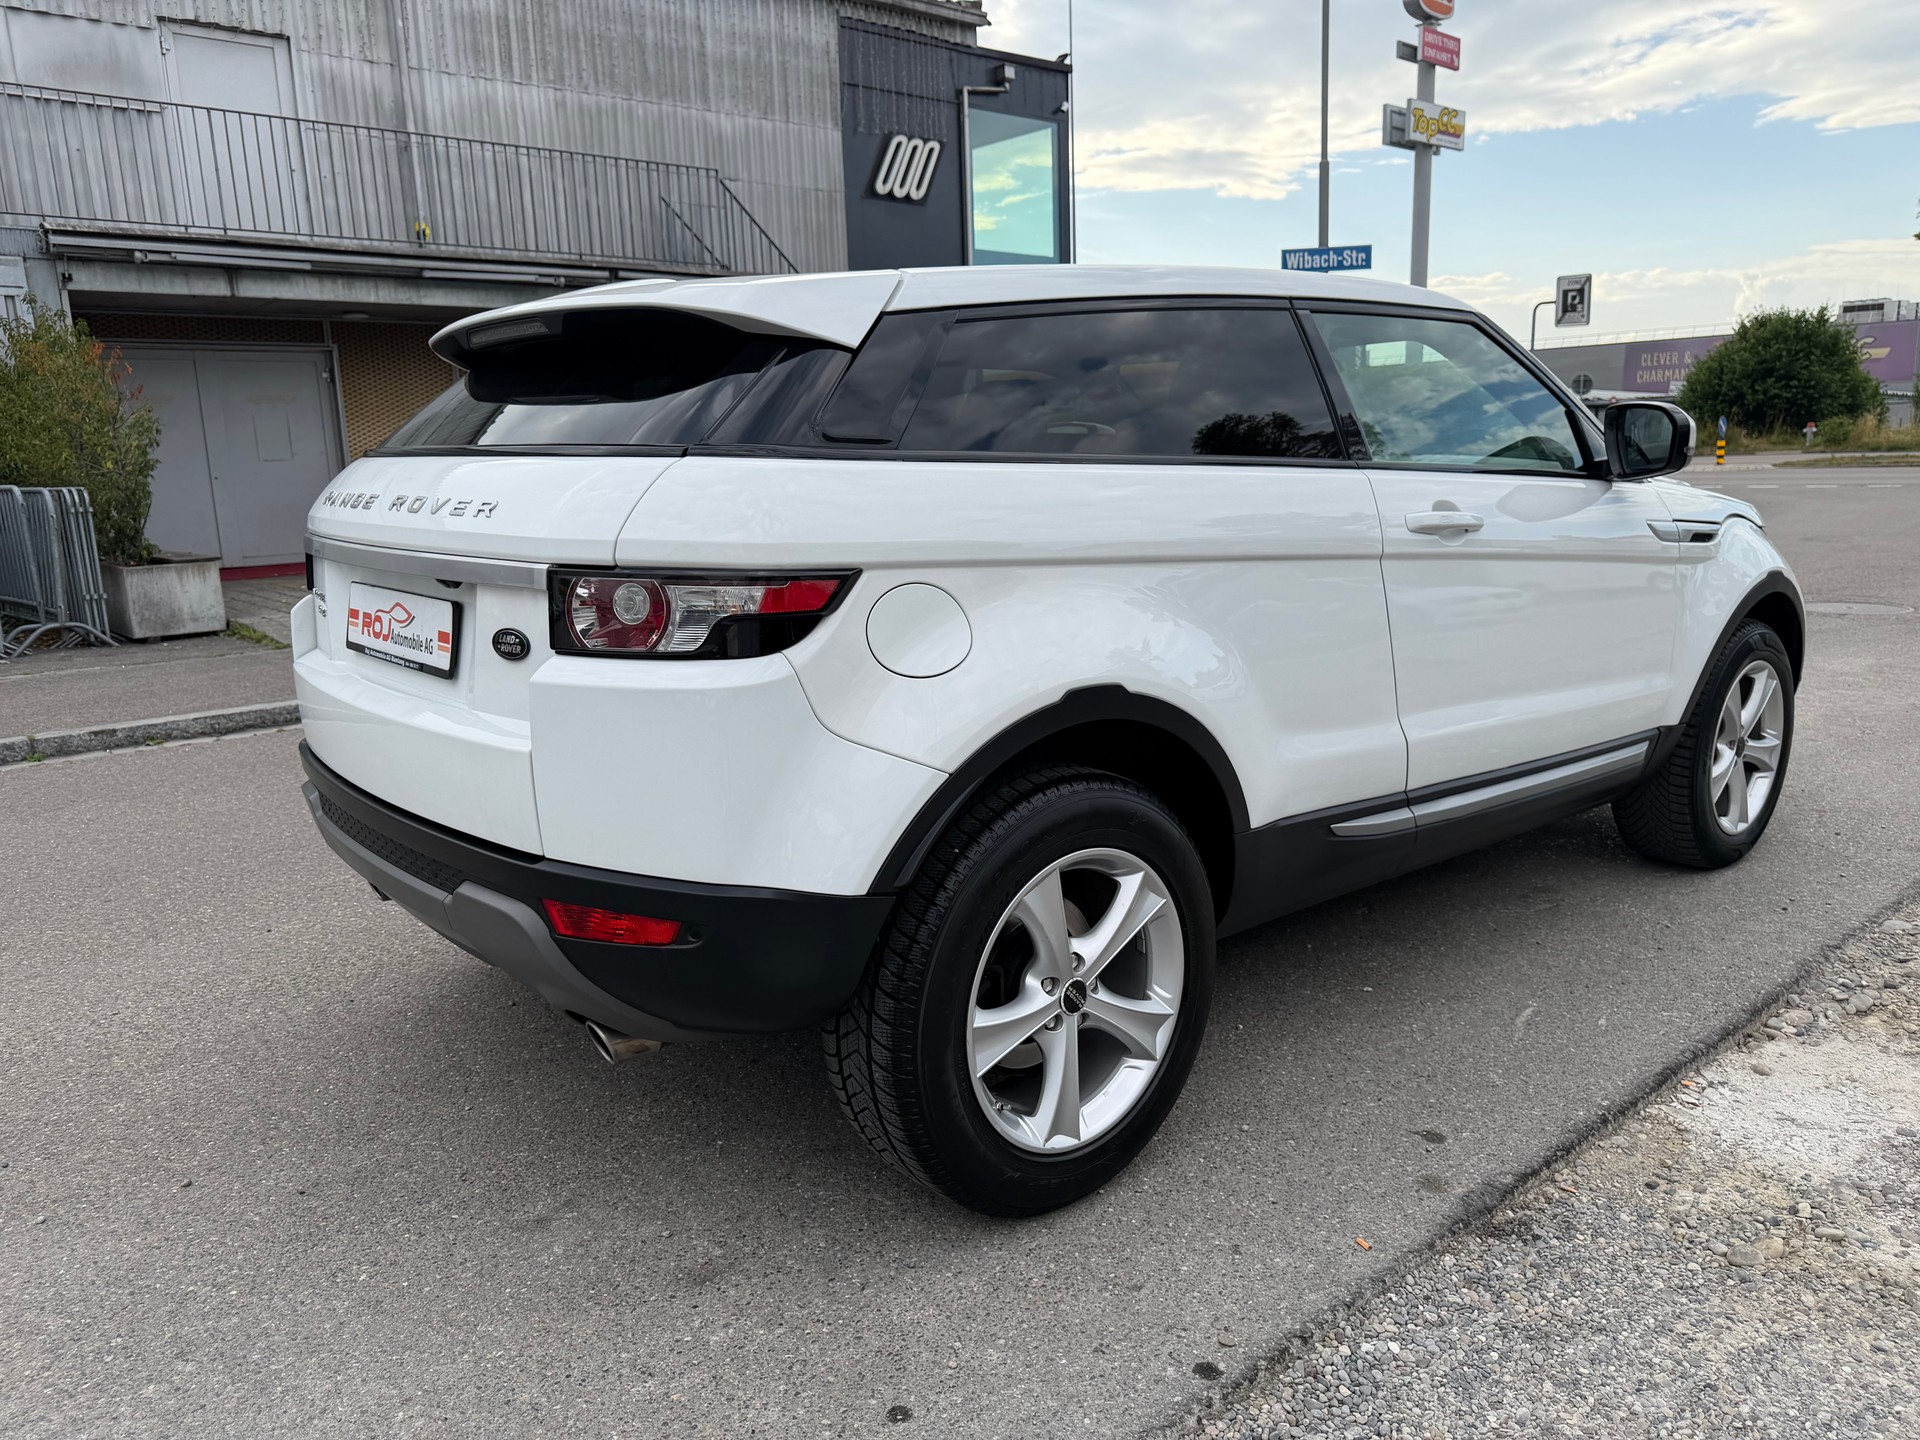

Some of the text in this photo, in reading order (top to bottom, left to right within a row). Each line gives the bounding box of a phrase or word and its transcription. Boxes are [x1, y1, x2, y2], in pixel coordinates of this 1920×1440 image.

[1285, 249, 1366, 270] Wibach-Str.
[1641, 350, 1692, 367] CLEVER &
[322, 490, 499, 518] RANGE ROVER
[361, 612, 434, 655] ROJ Automobile AG
[499, 633, 515, 644] LAND
[500, 643, 521, 654] ROVER
